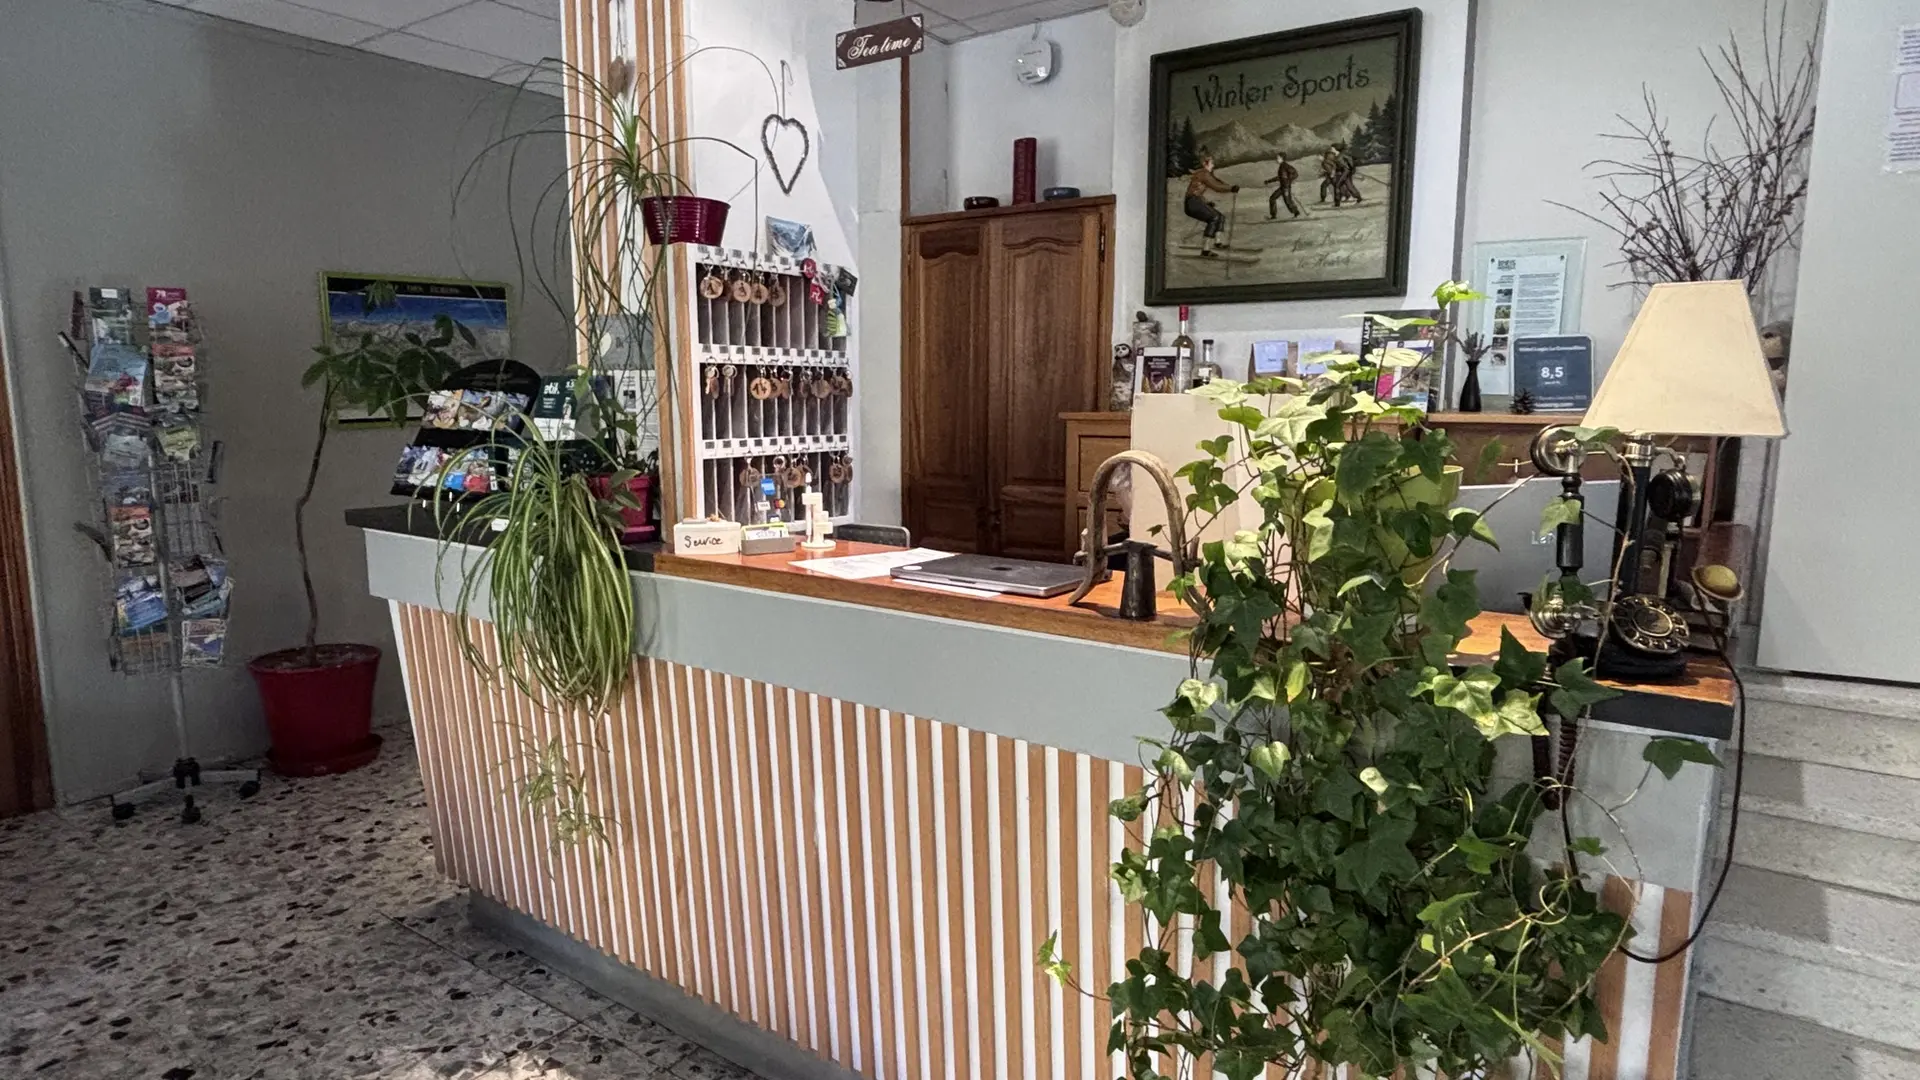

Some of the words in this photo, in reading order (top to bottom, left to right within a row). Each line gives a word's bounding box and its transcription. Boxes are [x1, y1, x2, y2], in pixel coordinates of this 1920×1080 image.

[847, 34, 878, 60] Tea
[879, 36, 912, 53] time
[1193, 73, 1273, 113] Winter
[1283, 54, 1370, 105] Sports
[1541, 366, 1564, 379] 8,5
[684, 535, 724, 548] Service
